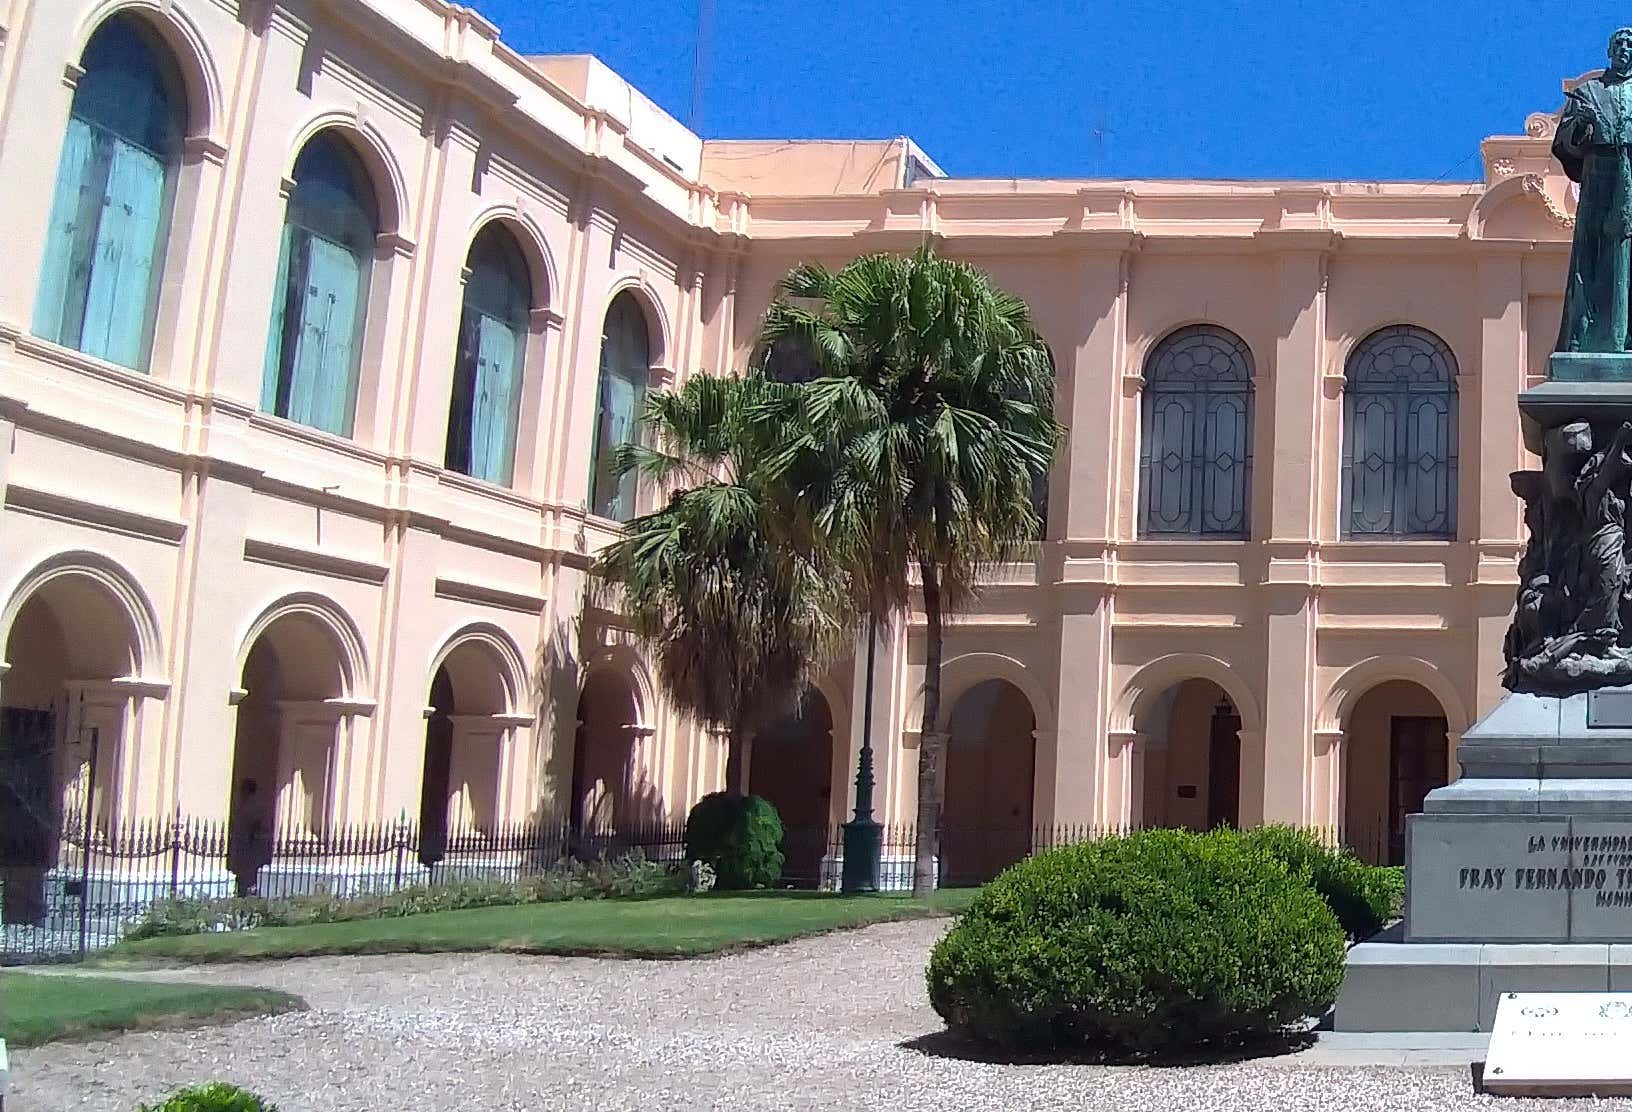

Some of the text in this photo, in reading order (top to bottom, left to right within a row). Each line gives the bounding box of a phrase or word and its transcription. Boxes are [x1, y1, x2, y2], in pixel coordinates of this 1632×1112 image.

[1528, 835, 1545, 853] LA
[1459, 868, 1505, 890] FRAY
[1515, 868, 1607, 890] FERNANDO
